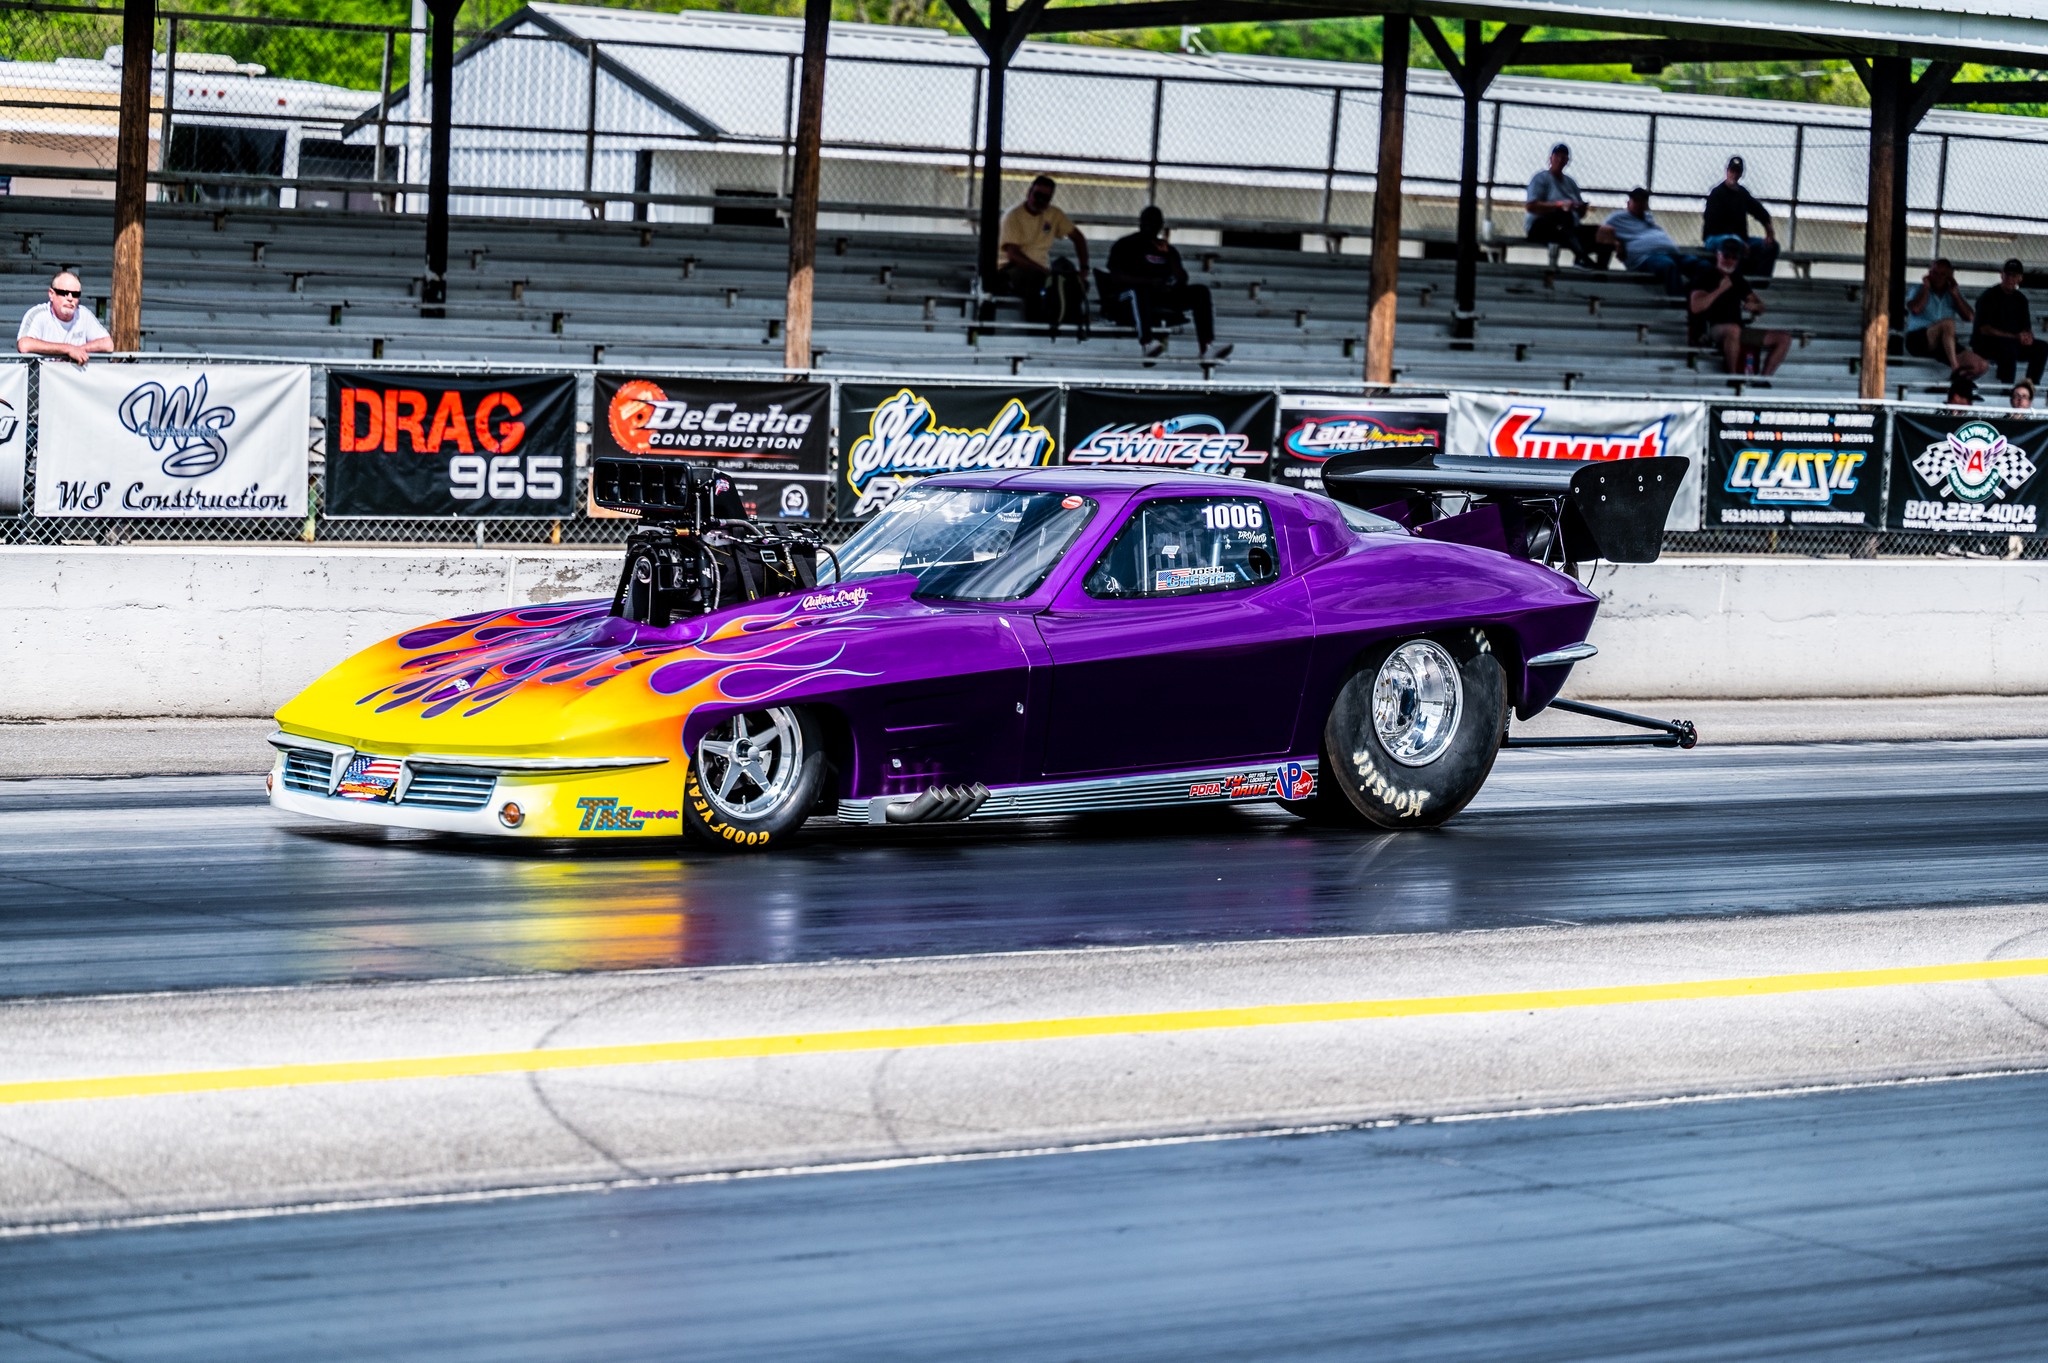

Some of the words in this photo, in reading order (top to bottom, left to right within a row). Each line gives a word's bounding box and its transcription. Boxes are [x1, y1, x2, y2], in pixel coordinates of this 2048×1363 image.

[119, 373, 235, 477] WS
[339, 388, 526, 454] DRAG
[642, 399, 812, 434] DeCerbo
[649, 432, 802, 450] CONSTRUCTION
[848, 389, 1052, 490] Shameless
[1068, 433, 1269, 464] SWITZER
[717, 460, 744, 469] RAPID
[746, 461, 800, 471] PRODUCTION
[1967, 450, 1983, 472] A
[449, 455, 564, 499] 965
[57, 481, 110, 511] WS
[123, 482, 288, 511] Construction
[1201, 504, 1263, 529] 1006
[1904, 500, 2037, 523] 800-222-4004
[803, 593, 835, 609] Custom
[836, 587, 868, 605] Crafts
[1189, 783, 1220, 796] PDRA
[1231, 783, 1270, 797] DRIVE
[1276, 762, 1302, 799] VP
[1294, 780, 1313, 794] Racing
[1353, 750, 1431, 817] Hoosier
